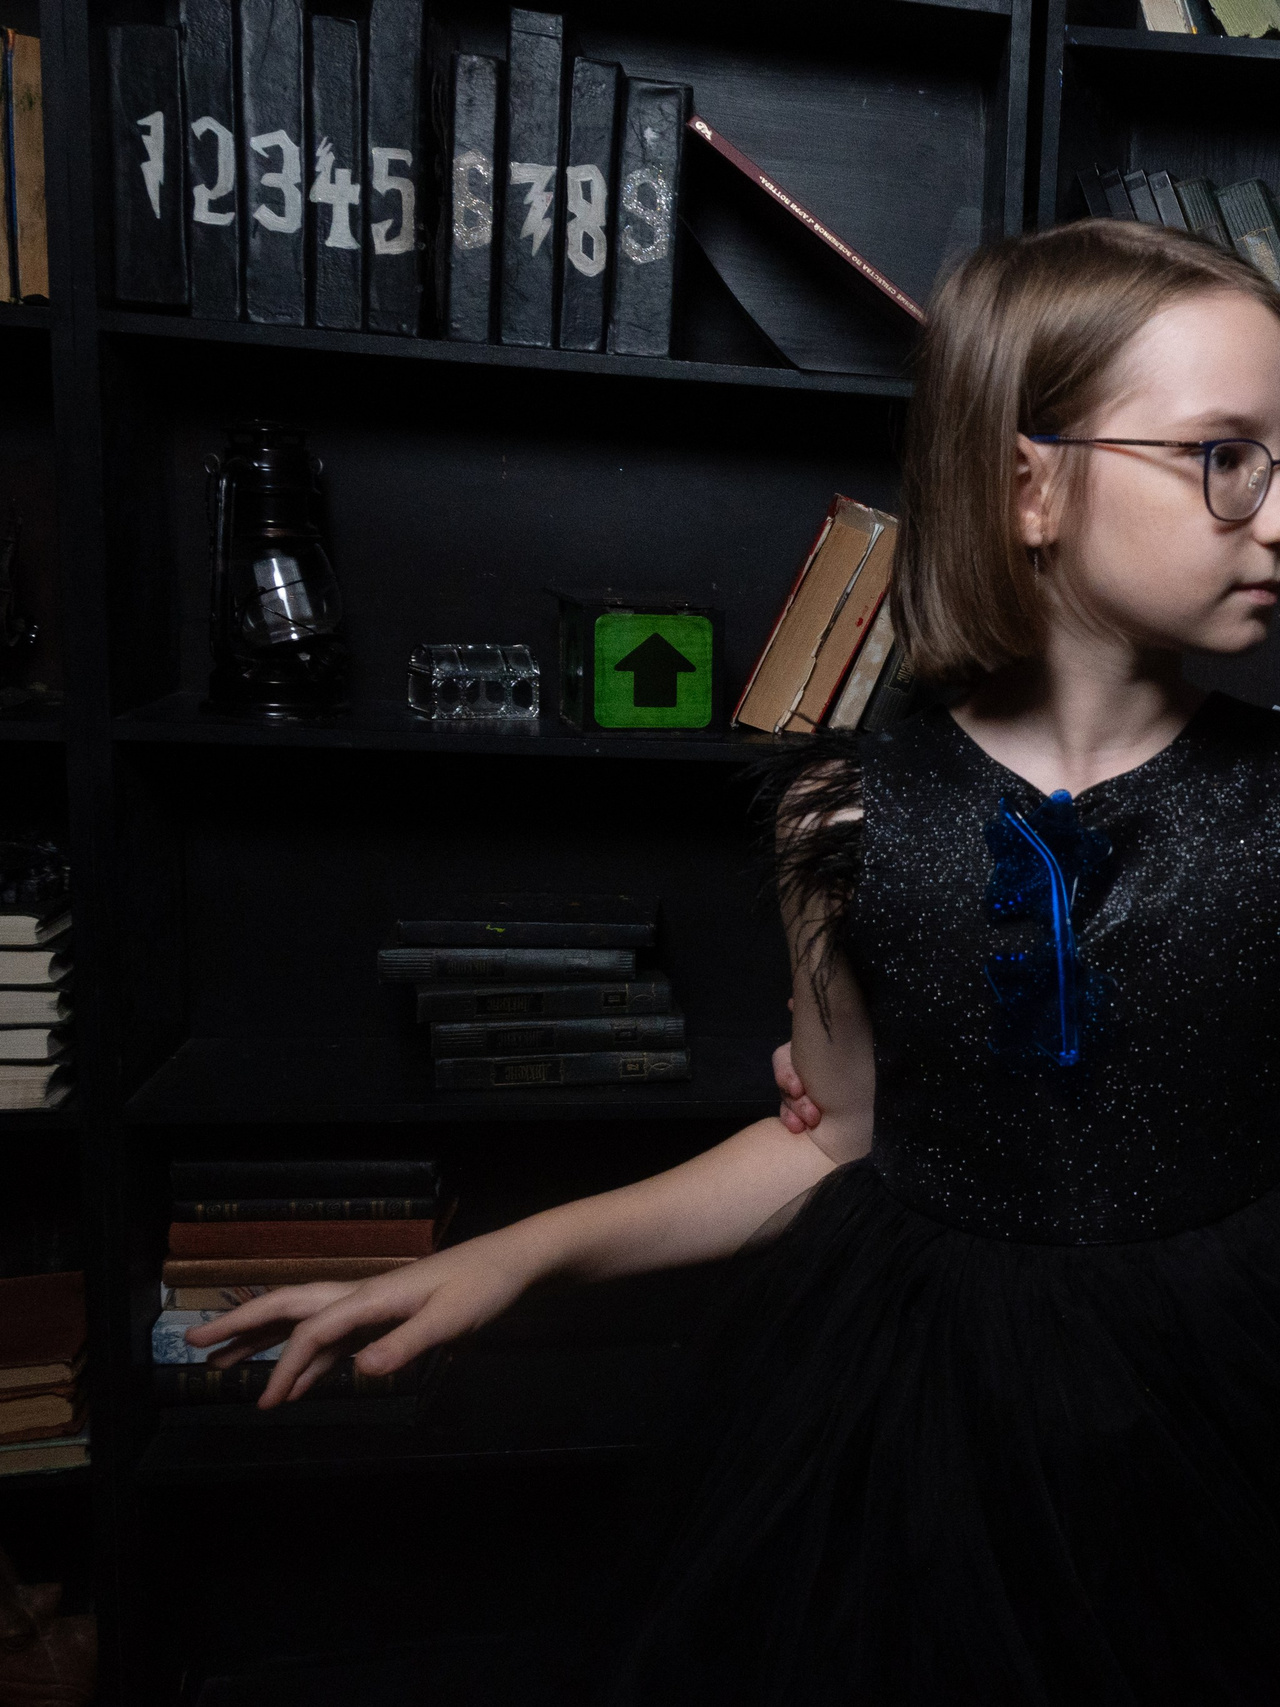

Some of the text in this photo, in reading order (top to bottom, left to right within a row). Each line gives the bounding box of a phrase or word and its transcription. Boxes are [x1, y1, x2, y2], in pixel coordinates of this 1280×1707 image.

[137, 110, 164, 219] 1
[191, 116, 235, 226] 2
[250, 130, 301, 233] 3
[309, 137, 360, 249] 4
[371, 147, 416, 255] 5
[510, 162, 557, 257] 7
[567, 164, 607, 277] 8
[622, 164, 672, 265] 9
[852, 255, 863, 266] ПО
